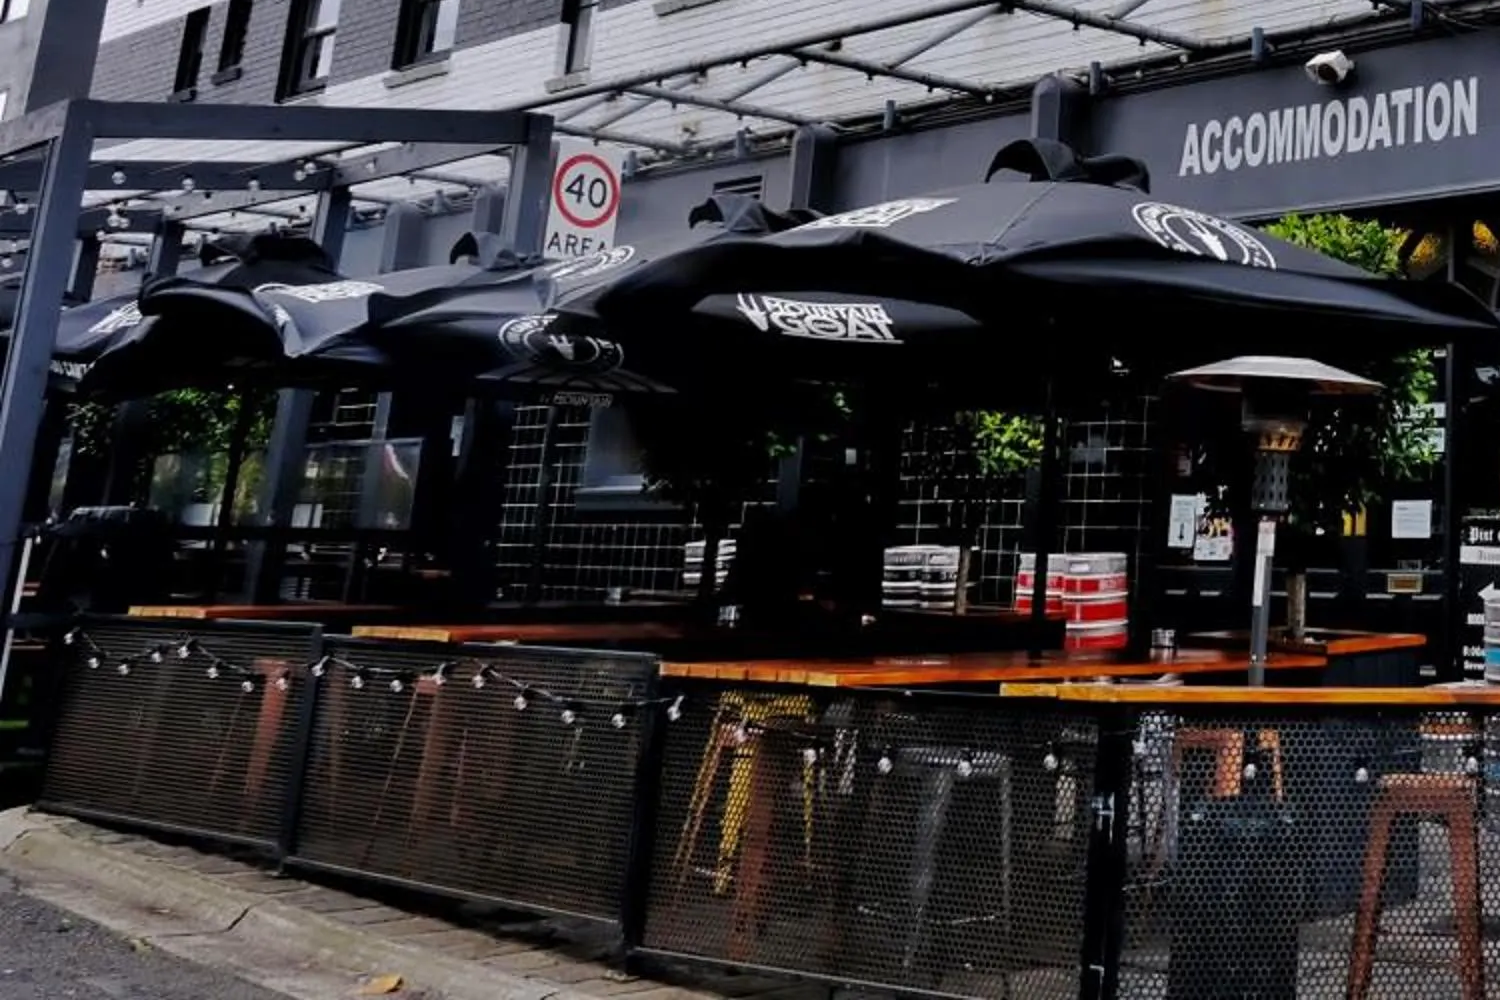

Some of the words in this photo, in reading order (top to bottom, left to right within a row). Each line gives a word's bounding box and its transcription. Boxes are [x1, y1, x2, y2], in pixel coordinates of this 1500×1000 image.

[1179, 77, 1478, 177] ACCOMMODATION
[565, 173, 607, 208] 40
[761, 295, 893, 325] MOUNTAIN
[768, 312, 896, 342] GOAT
